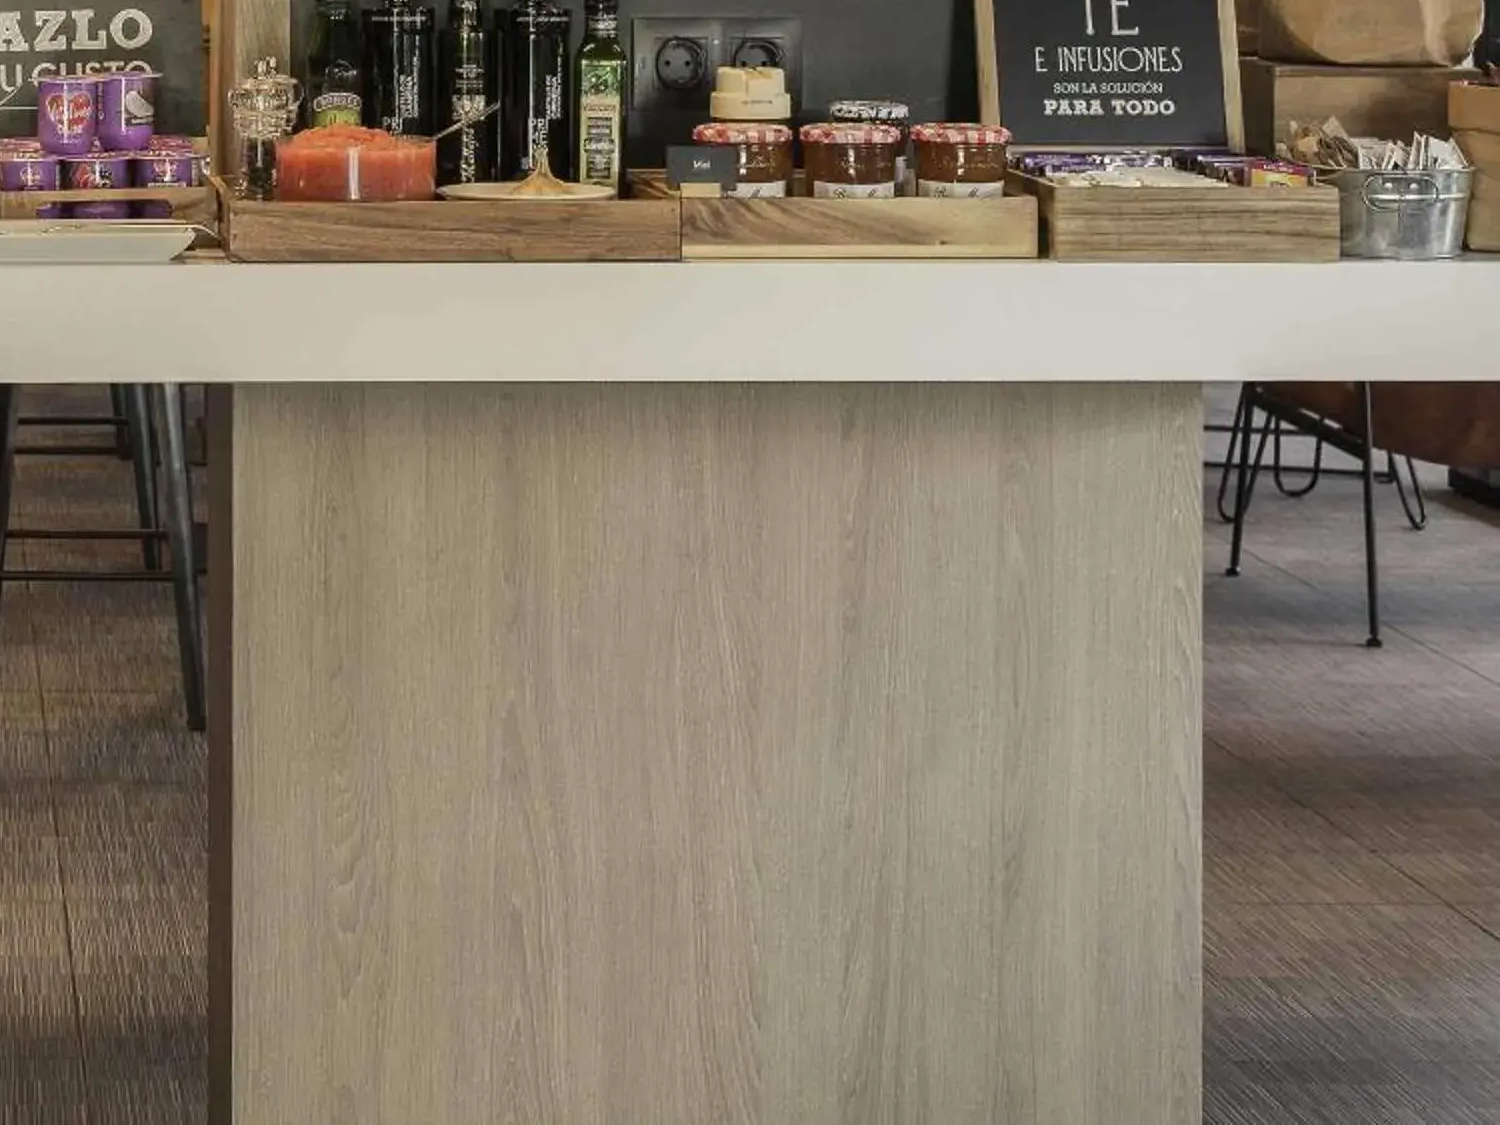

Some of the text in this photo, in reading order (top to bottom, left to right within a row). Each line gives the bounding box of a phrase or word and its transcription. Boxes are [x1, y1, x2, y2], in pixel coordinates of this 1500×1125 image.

[1035, 46, 1183, 72] E INFUSIONES
[1053, 81, 1163, 94] SON LA SOLUCIÓN
[1043, 99, 1175, 115] PARA TODO
